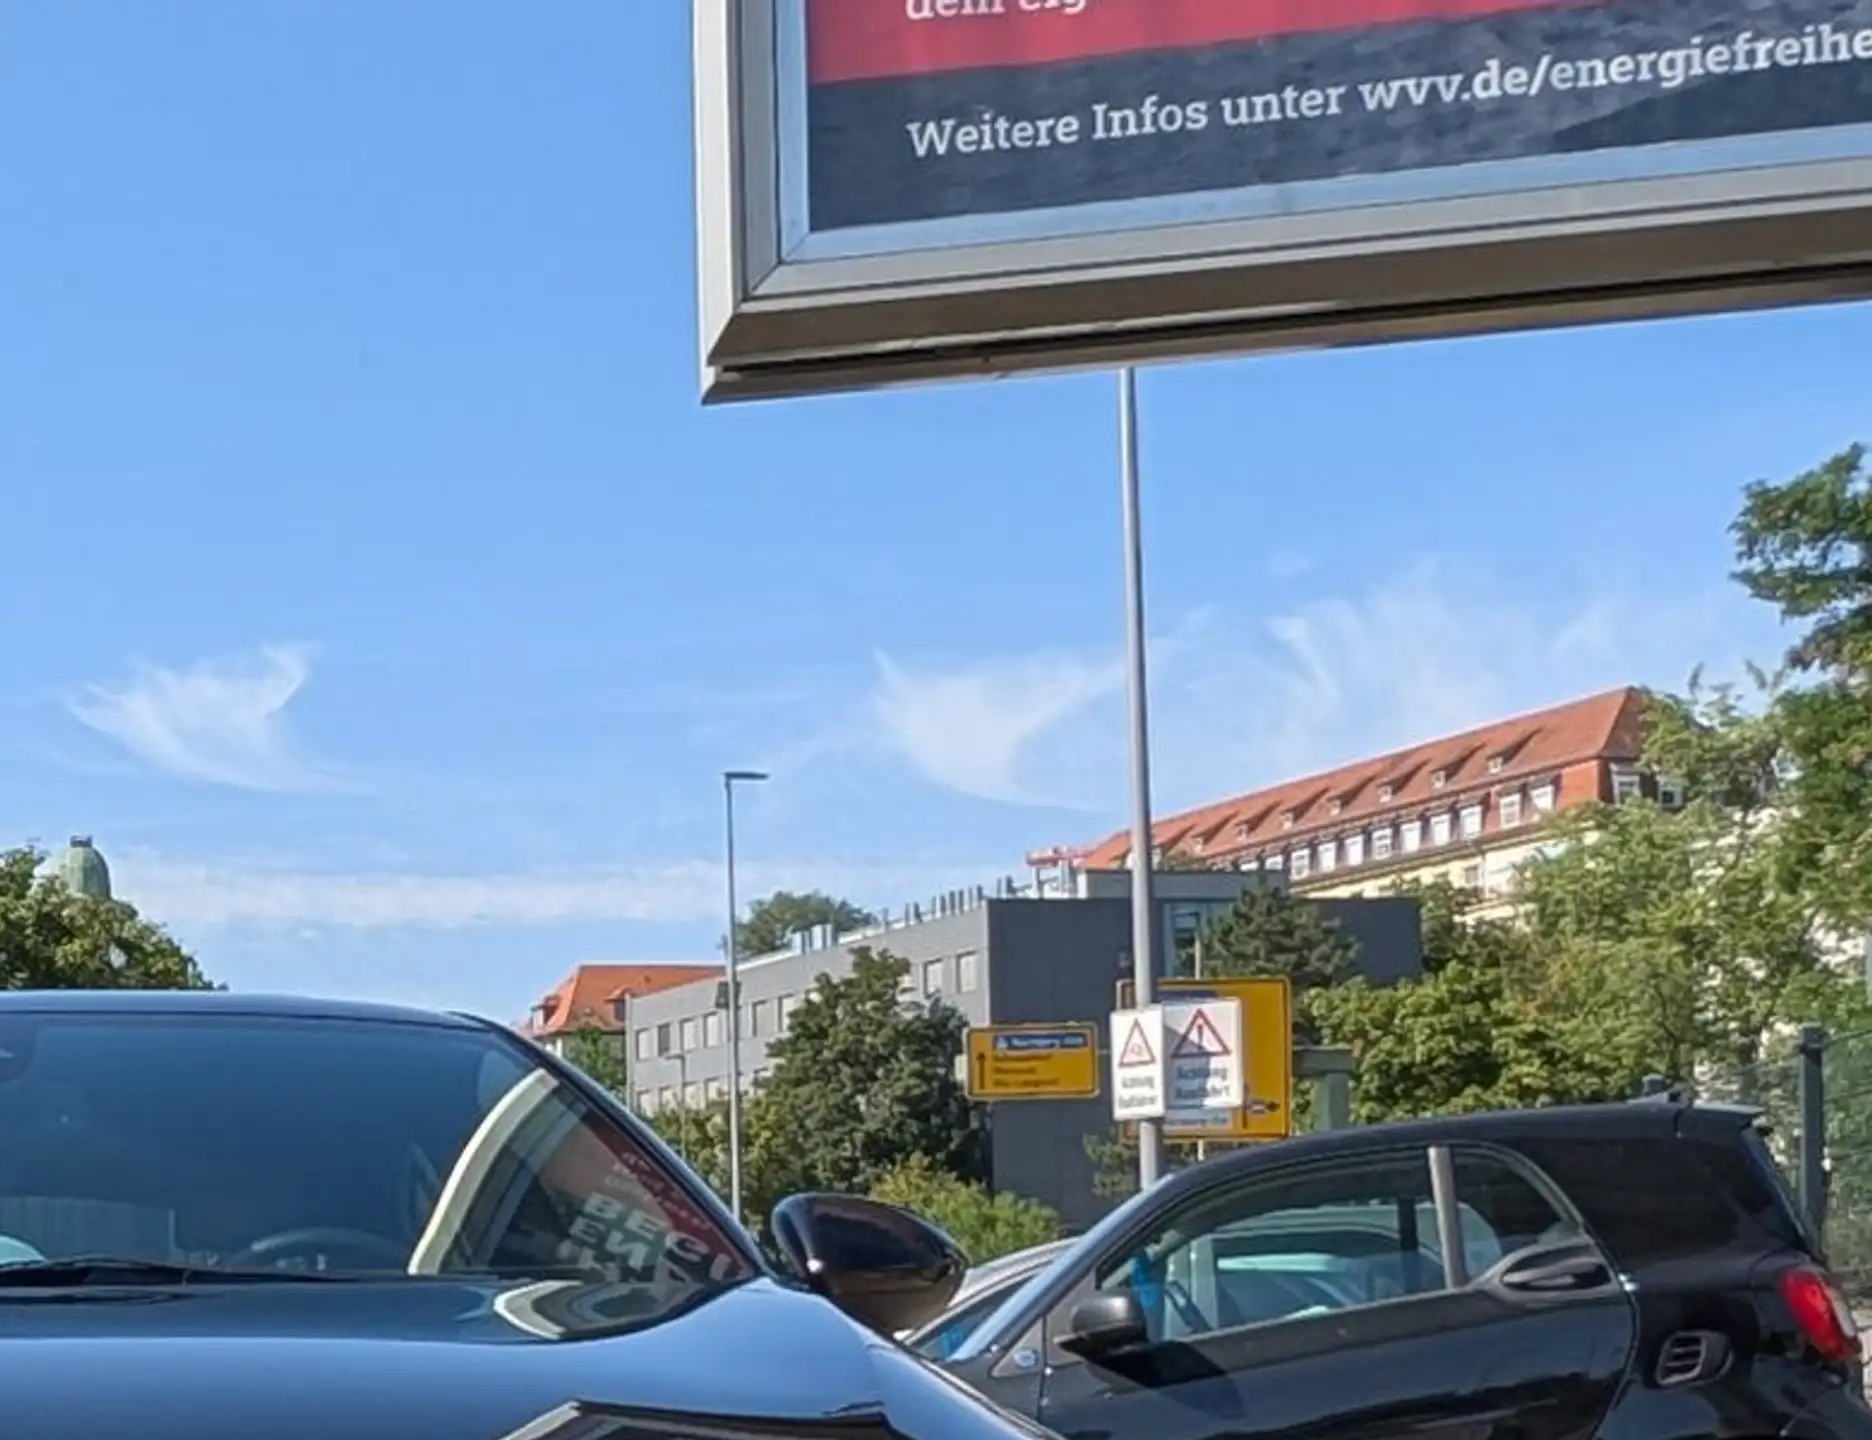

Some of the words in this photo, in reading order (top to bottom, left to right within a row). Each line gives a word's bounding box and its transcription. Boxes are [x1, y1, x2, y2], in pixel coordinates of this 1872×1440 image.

[906, 113, 1081, 157] Weitere
[1092, 94, 1209, 141] Infos
[1219, 81, 1347, 126] unter
[1358, 22, 1872, 110] wvv.de/energiefreihe
